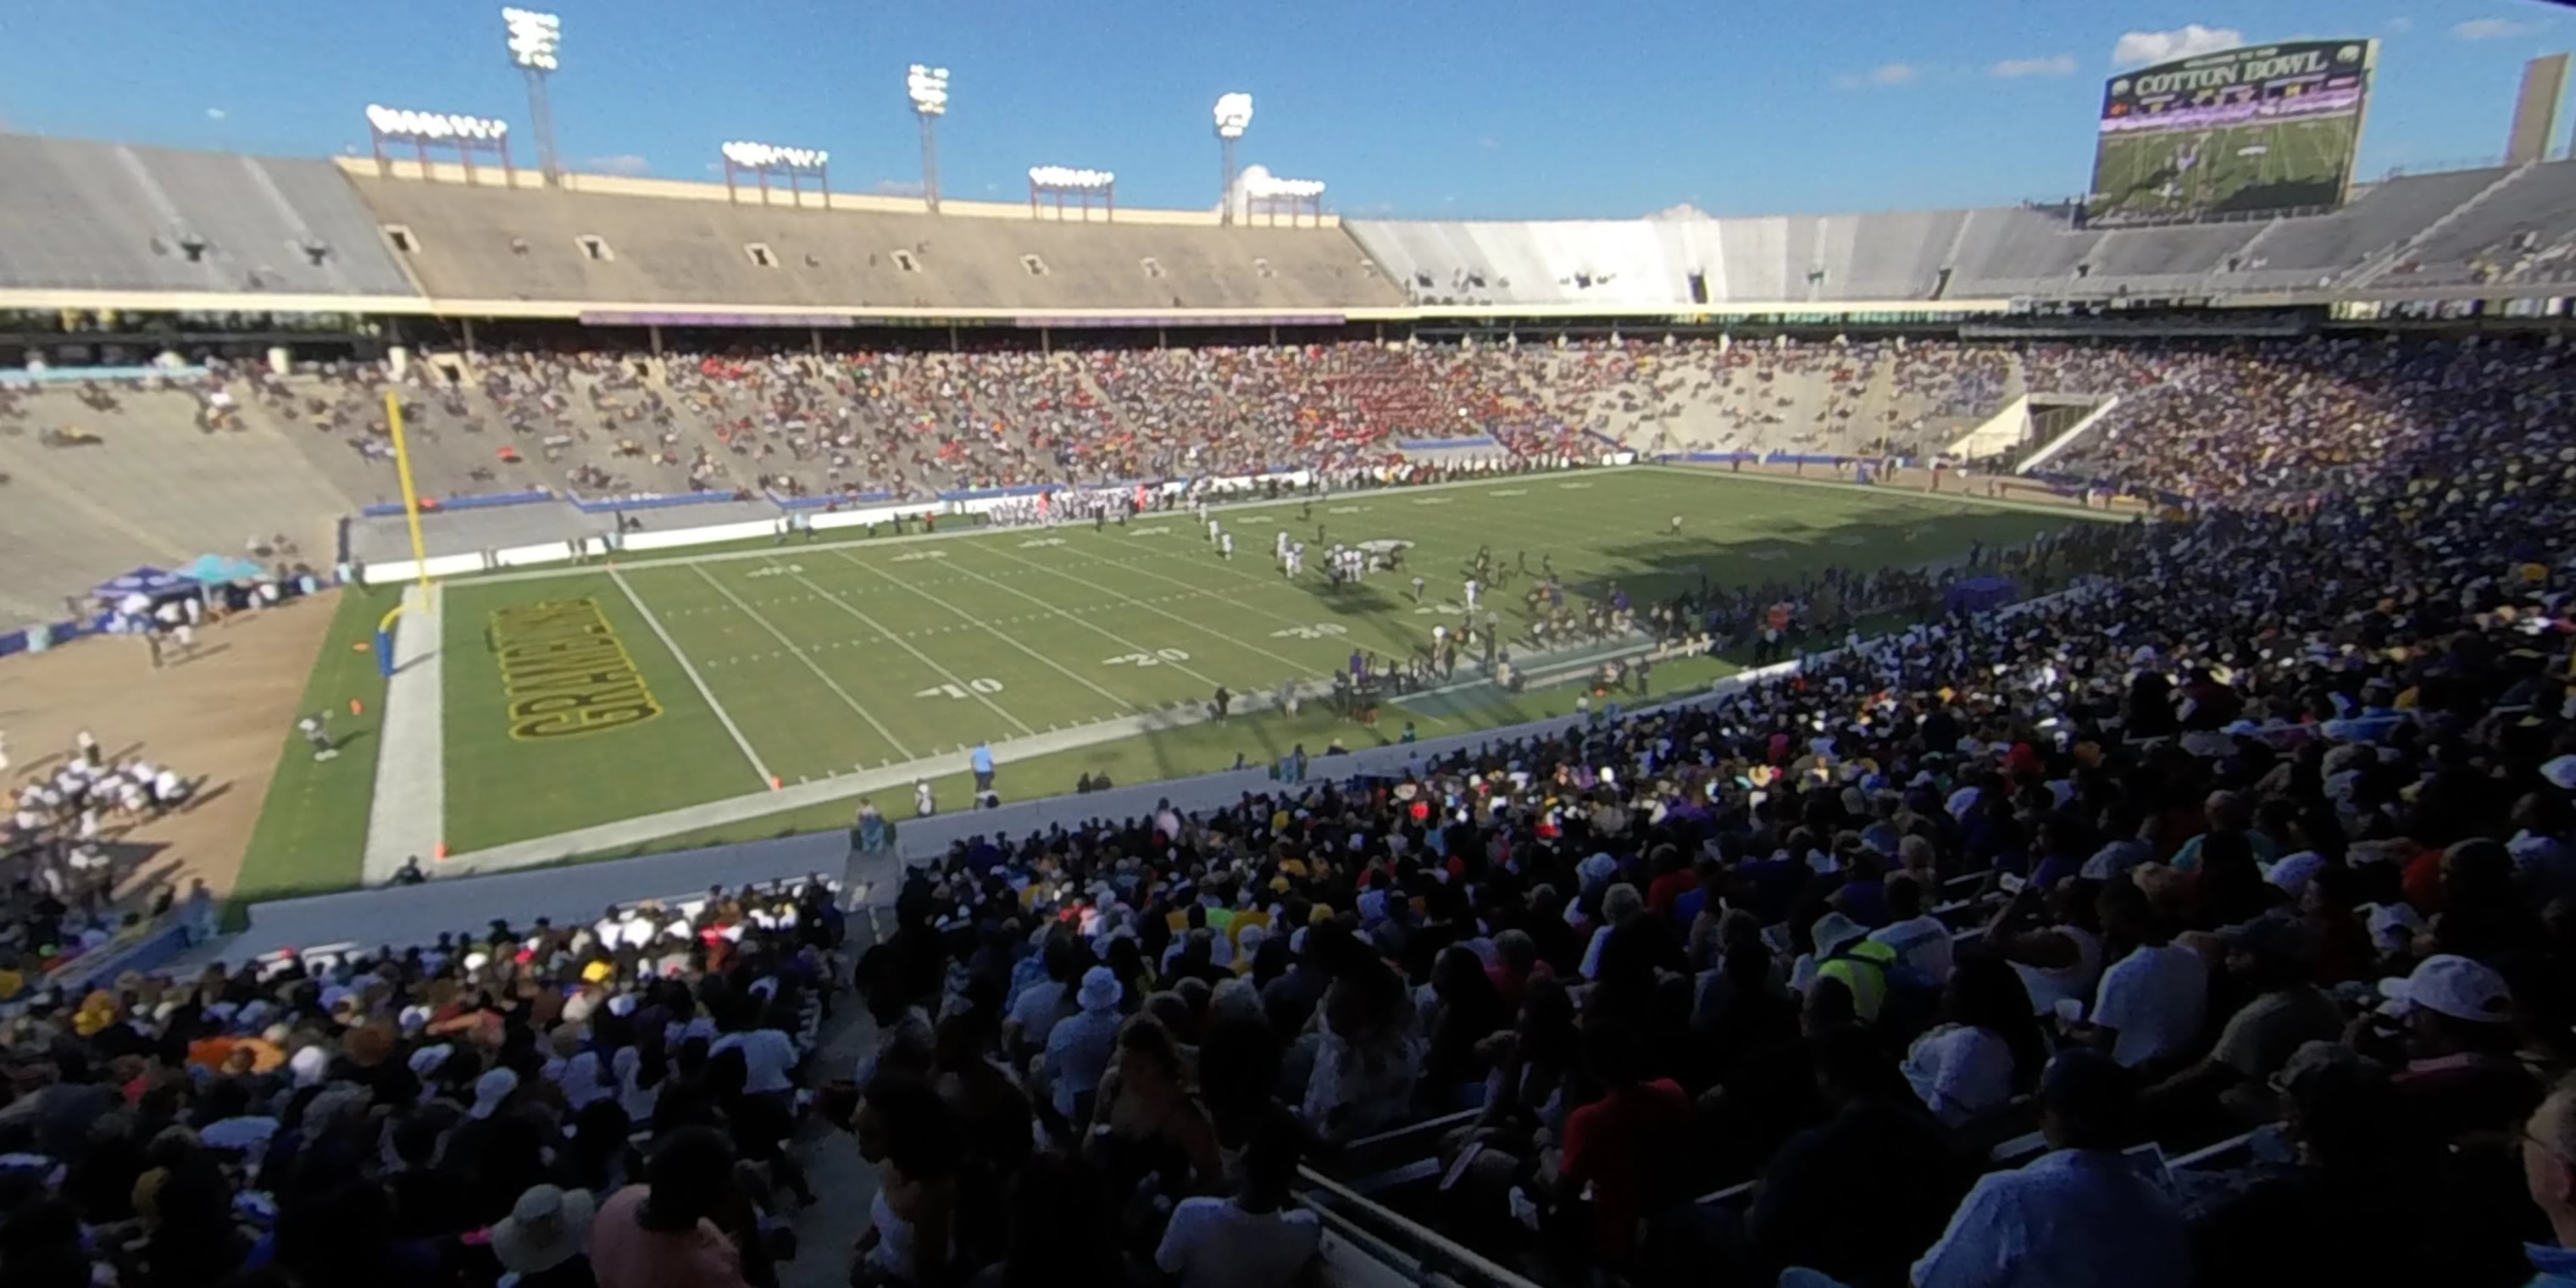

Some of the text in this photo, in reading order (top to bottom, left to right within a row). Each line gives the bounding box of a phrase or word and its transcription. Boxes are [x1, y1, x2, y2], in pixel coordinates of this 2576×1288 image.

[2135, 64, 2239, 96] COTTON
[2243, 50, 2329, 81] BOWL
[1124, 647, 1191, 667] 20
[941, 677, 1004, 699] 10
